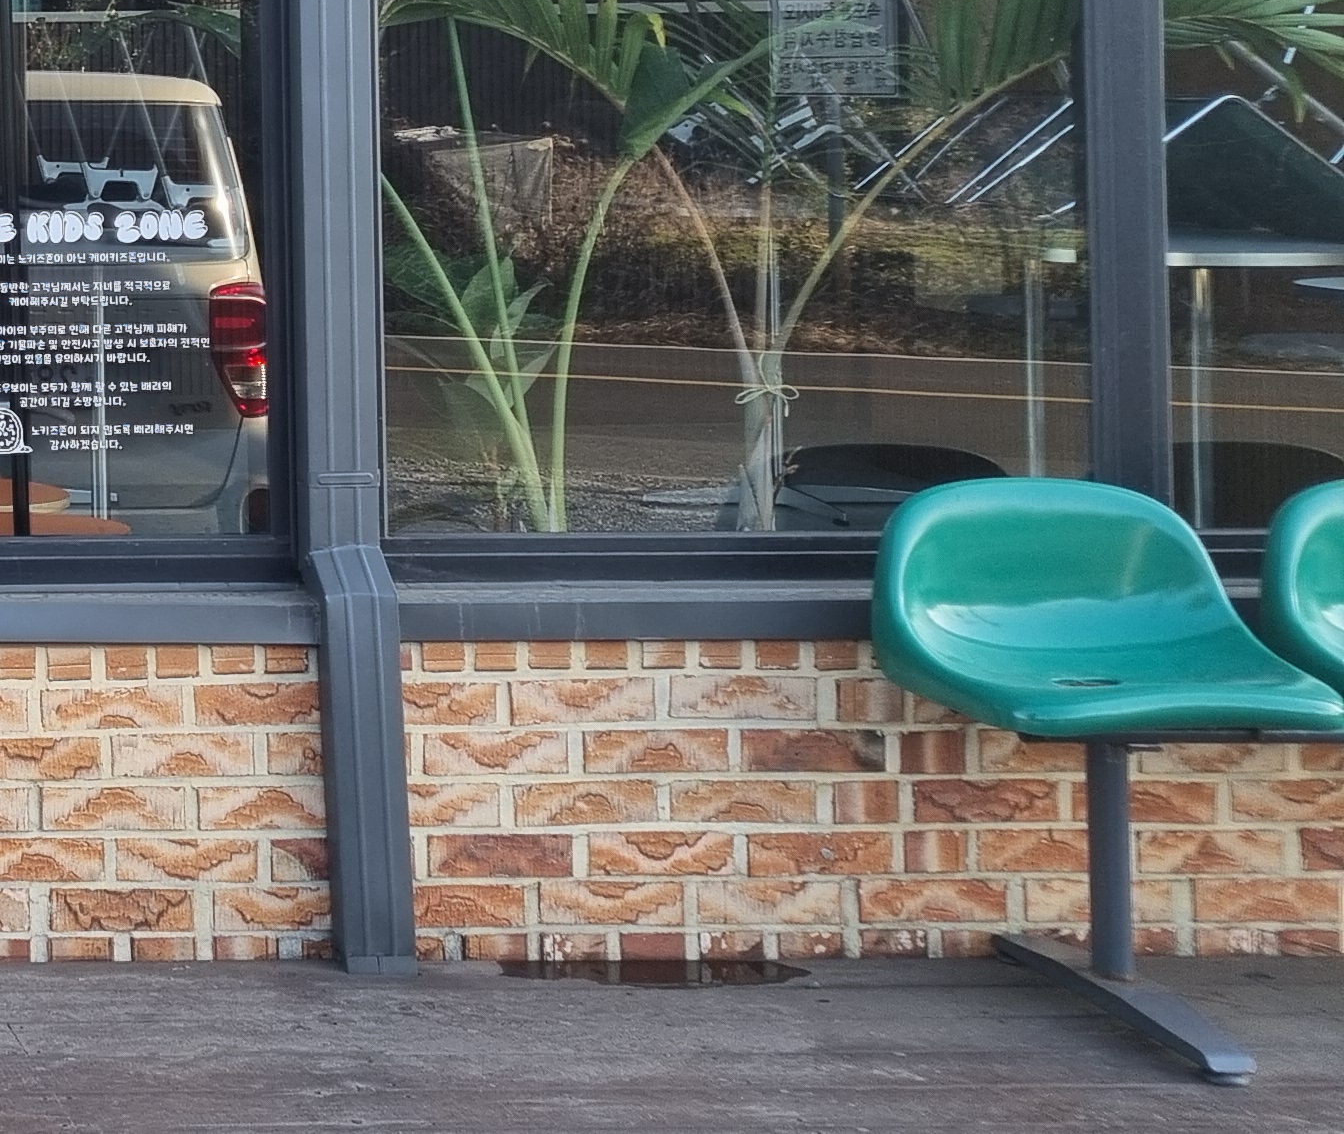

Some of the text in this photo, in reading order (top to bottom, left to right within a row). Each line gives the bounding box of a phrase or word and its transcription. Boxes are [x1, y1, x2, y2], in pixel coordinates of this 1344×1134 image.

[27, 211, 104, 243] KIDS
[114, 209, 208, 243] ZONE
[18, 253, 63, 264] 노키즈존이
[66, 252, 86, 263] 아닌
[89, 251, 171, 263] 케어키즈존입니다.
[0, 282, 30, 294] 동반한
[32, 281, 91, 293] 고객님께서는
[92, 281, 122, 293] 자녀를
[124, 280, 171, 292] 적극적으로
[8, 295, 133, 308] 케어해주시길 부탁드립니다.
[29, 324, 66, 336] 부주의로
[69, 324, 90, 335] 인해
[92, 323, 112, 335] 다른
[114, 323, 154, 335] 고객님께
[156, 323, 188, 334] 피해가
[8, 339, 46, 351] 기물파손
[48, 339, 58, 351] 및
[61, 338, 100, 350] 안전사고
[103, 338, 124, 350] 발생
[126, 338, 137, 348] 시
[139, 337, 178, 349] 보호자의
[24, 353, 52, 365] 있음을
[54, 353, 103, 364] 유의하시기
[106, 352, 151, 363] 바랍니다.
[40, 382, 68, 393] 모두가
[70, 381, 92, 393] 함께
[108, 381, 117, 393] 수
[119, 381, 139, 392] 있는
[141, 381, 172, 392] 배려의
[19, 396, 127, 408] 공간이 되길 소망합니다.
[31, 425, 77, 436] 노키즈존이
[80, 425, 100, 436] 되지
[103, 424, 131, 436] 않도록
[49, 439, 123, 451] 감사하겠습니다.
